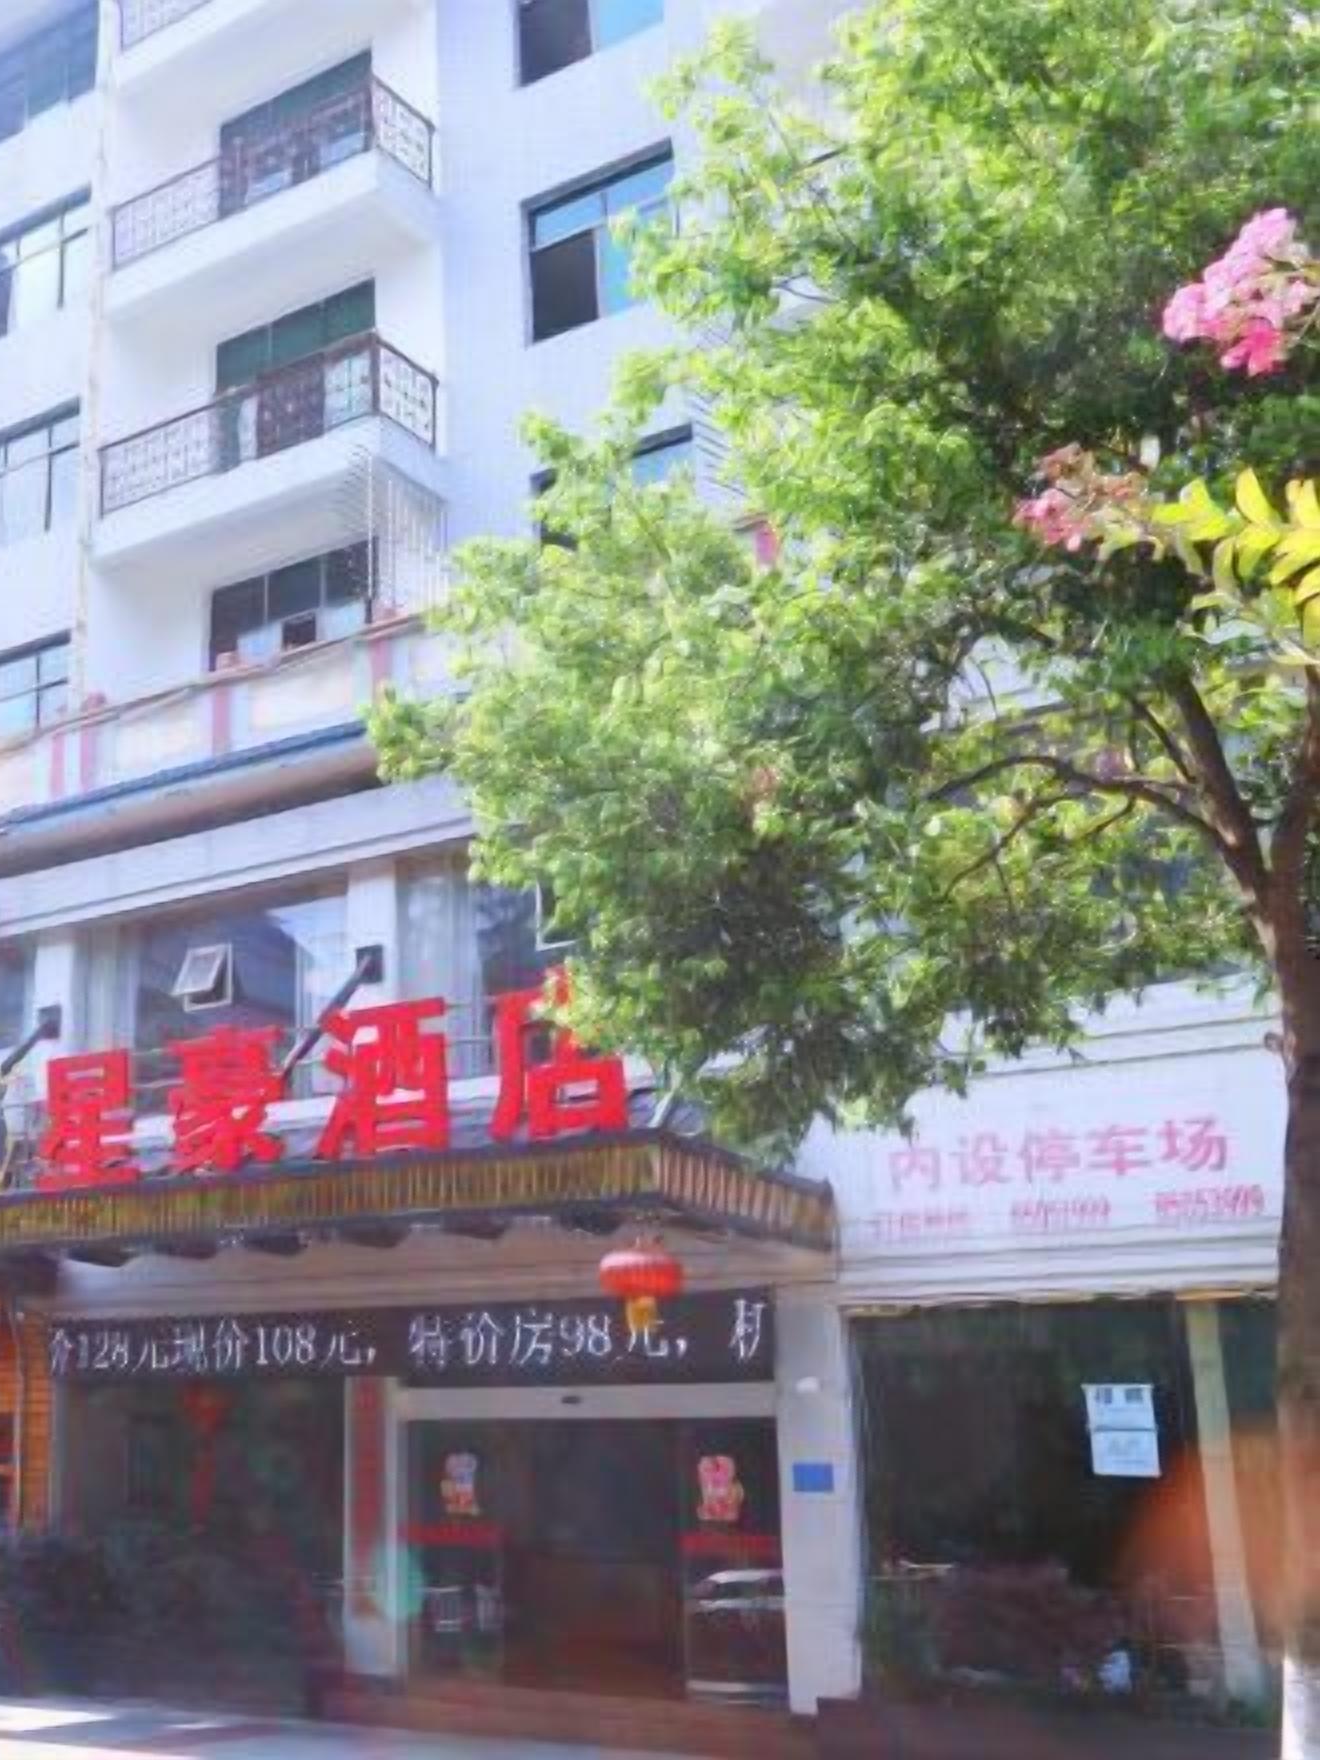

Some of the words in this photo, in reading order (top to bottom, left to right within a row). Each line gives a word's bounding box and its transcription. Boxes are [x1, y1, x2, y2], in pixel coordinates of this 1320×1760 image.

[34, 965, 628, 1191] 星豪酒店
[888, 1115, 1230, 1192] 内设停车场
